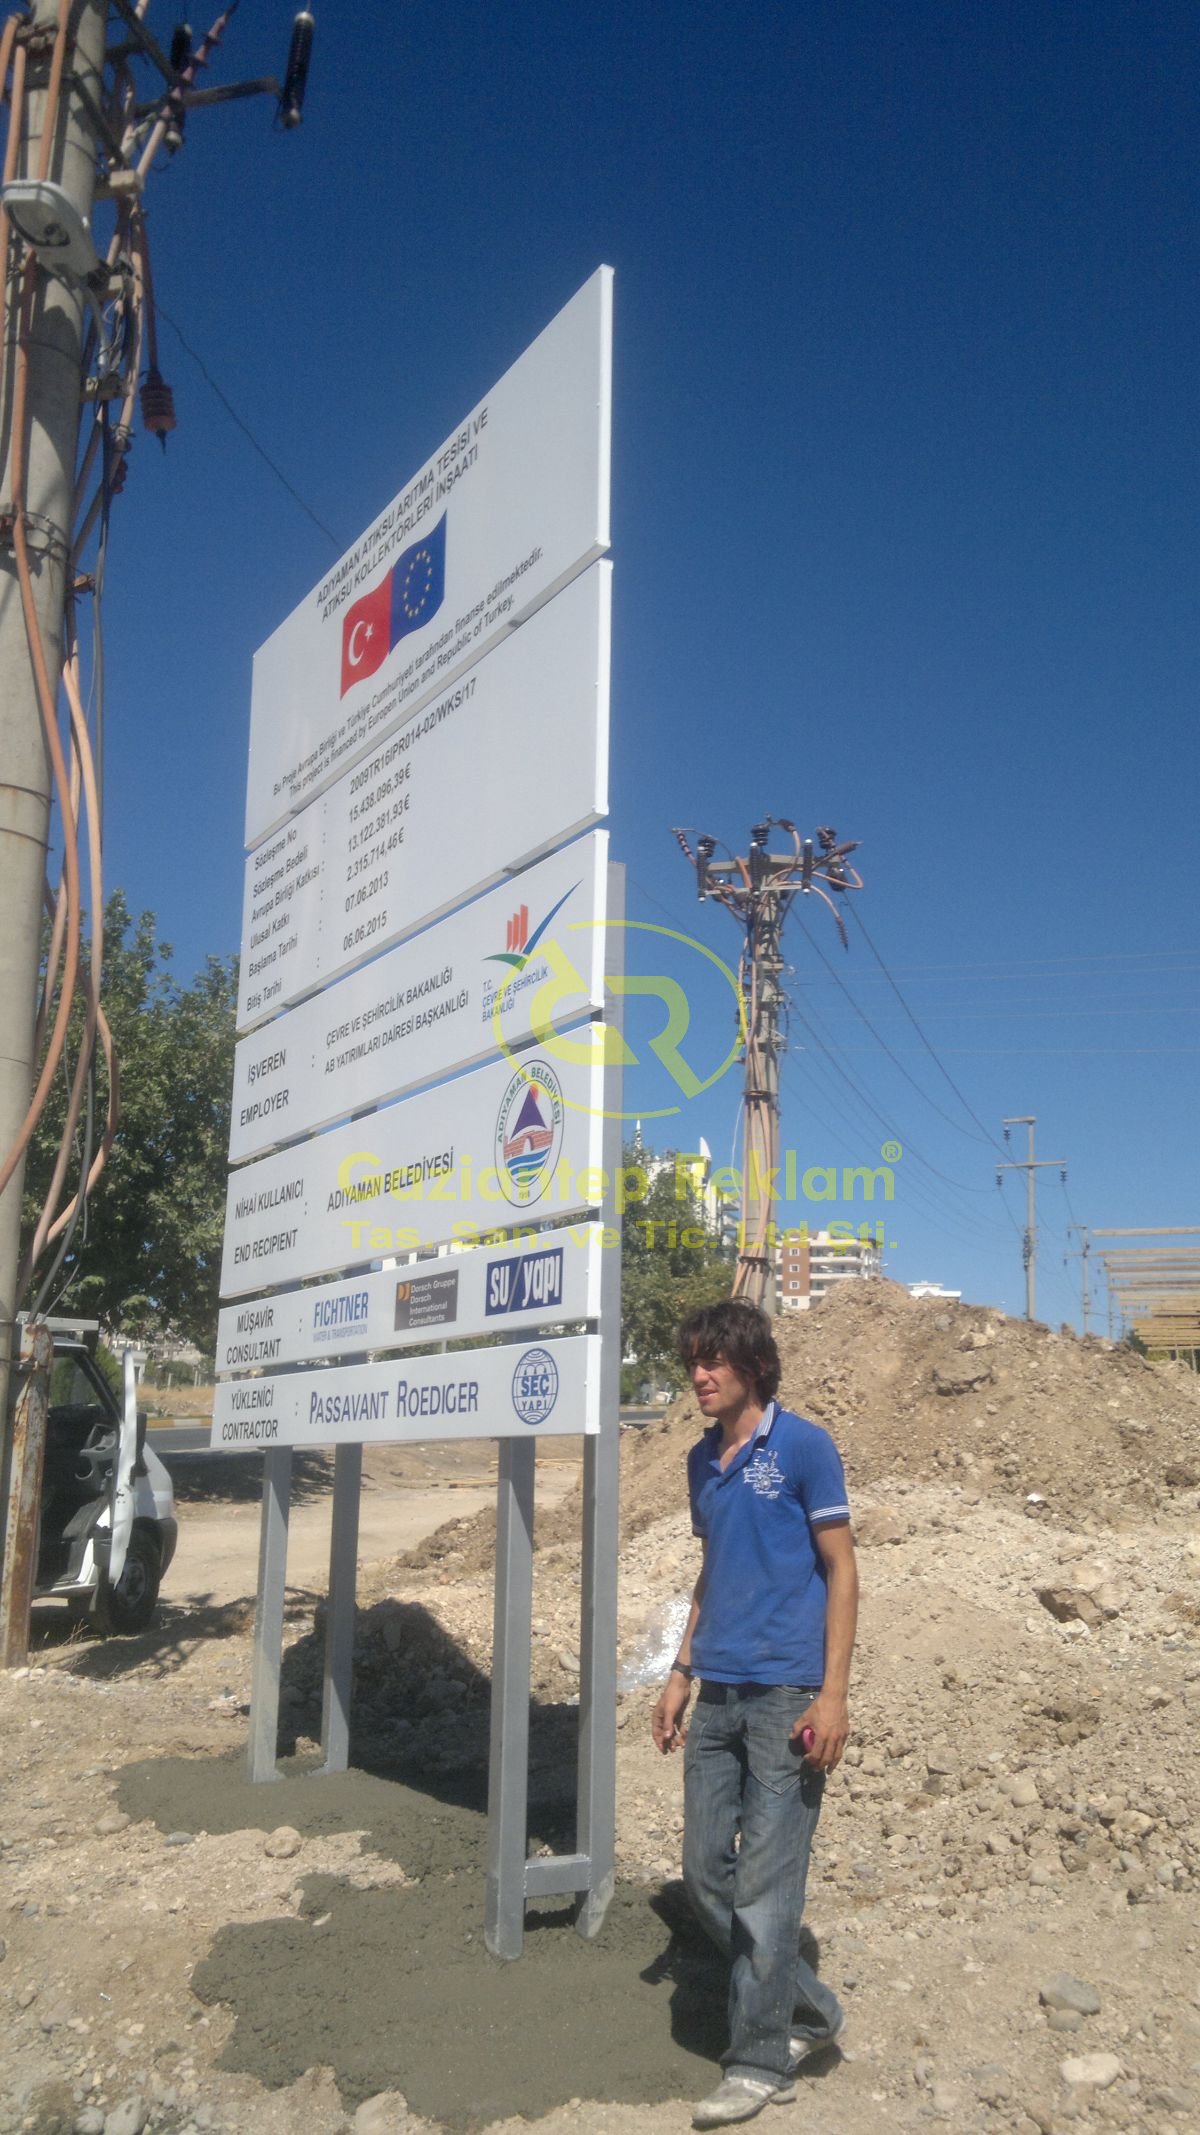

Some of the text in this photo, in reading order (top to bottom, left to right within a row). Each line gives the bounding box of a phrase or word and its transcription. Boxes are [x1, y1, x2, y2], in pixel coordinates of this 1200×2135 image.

[317, 547, 361, 608] ADIYAMAN
[361, 510, 395, 558] ATIKSU
[397, 469, 434, 521] ARITMA
[473, 407, 488, 435] VE
[322, 579, 352, 623] ATIKSU
[282, 769, 297, 788] Proje
[338, 726, 346, 737] ve
[347, 703, 370, 729] Türkiye
[372, 660, 414, 708] Cumhuriyeti
[455, 600, 485, 633] finanse
[290, 783, 301, 797] This
[302, 762, 323, 789] project
[324, 757, 330, 768] is
[330, 730, 357, 762] financed
[358, 724, 367, 738] by
[398, 678, 420, 703] Union
[421, 661, 436, 683] and
[437, 631, 472, 669] Republic
[473, 617, 483, 637] of
[255, 838, 286, 870] Sözleşme
[287, 829, 297, 844] No
[253, 867, 284, 898] Sözleşme
[286, 844, 308, 873] Bedeli
[251, 899, 274, 923] Avrupa
[278, 932, 298, 957] Tarihi
[345, 870, 389, 912] 07.06.2013
[250, 923, 271, 949] Ulusal
[263, 978, 282, 1000] Tarihi
[343, 911, 387, 951] 06.06.2015
[326, 966, 453, 1049] ÇEVRE VE ŞEHİRCİLİK BAKANLIĞI
[325, 990, 469, 1075] AB YATIRIMLARI DAİRESİ BAŞKANLIĞI
[248, 1048, 287, 1086] İŞVEREN
[240, 1089, 289, 1127] EMPLOYER
[498, 1071, 527, 1143] ADIYAMAN
[258, 1179, 304, 1212] KULLANICI
[327, 1176, 381, 1212] ADIYAMAN
[384, 1146, 453, 1193] BELEDİYESİ
[234, 1229, 298, 1264] END RECIPIENT
[410, 1294, 432, 1304] Dorsch
[411, 1278, 456, 1293] Dorsch Gruppe
[237, 1305, 274, 1335] MÜŞAVİR
[313, 1291, 369, 1328] FICHTNER
[408, 1314, 445, 1326] Consultants
[409, 1301, 448, 1315] International
[227, 1338, 281, 1365] CONSULTANT
[231, 1384, 274, 1410] YÜKLENİCİ
[522, 1400, 547, 1411] YAPI
[222, 1419, 278, 1440] CONTRACTOR
